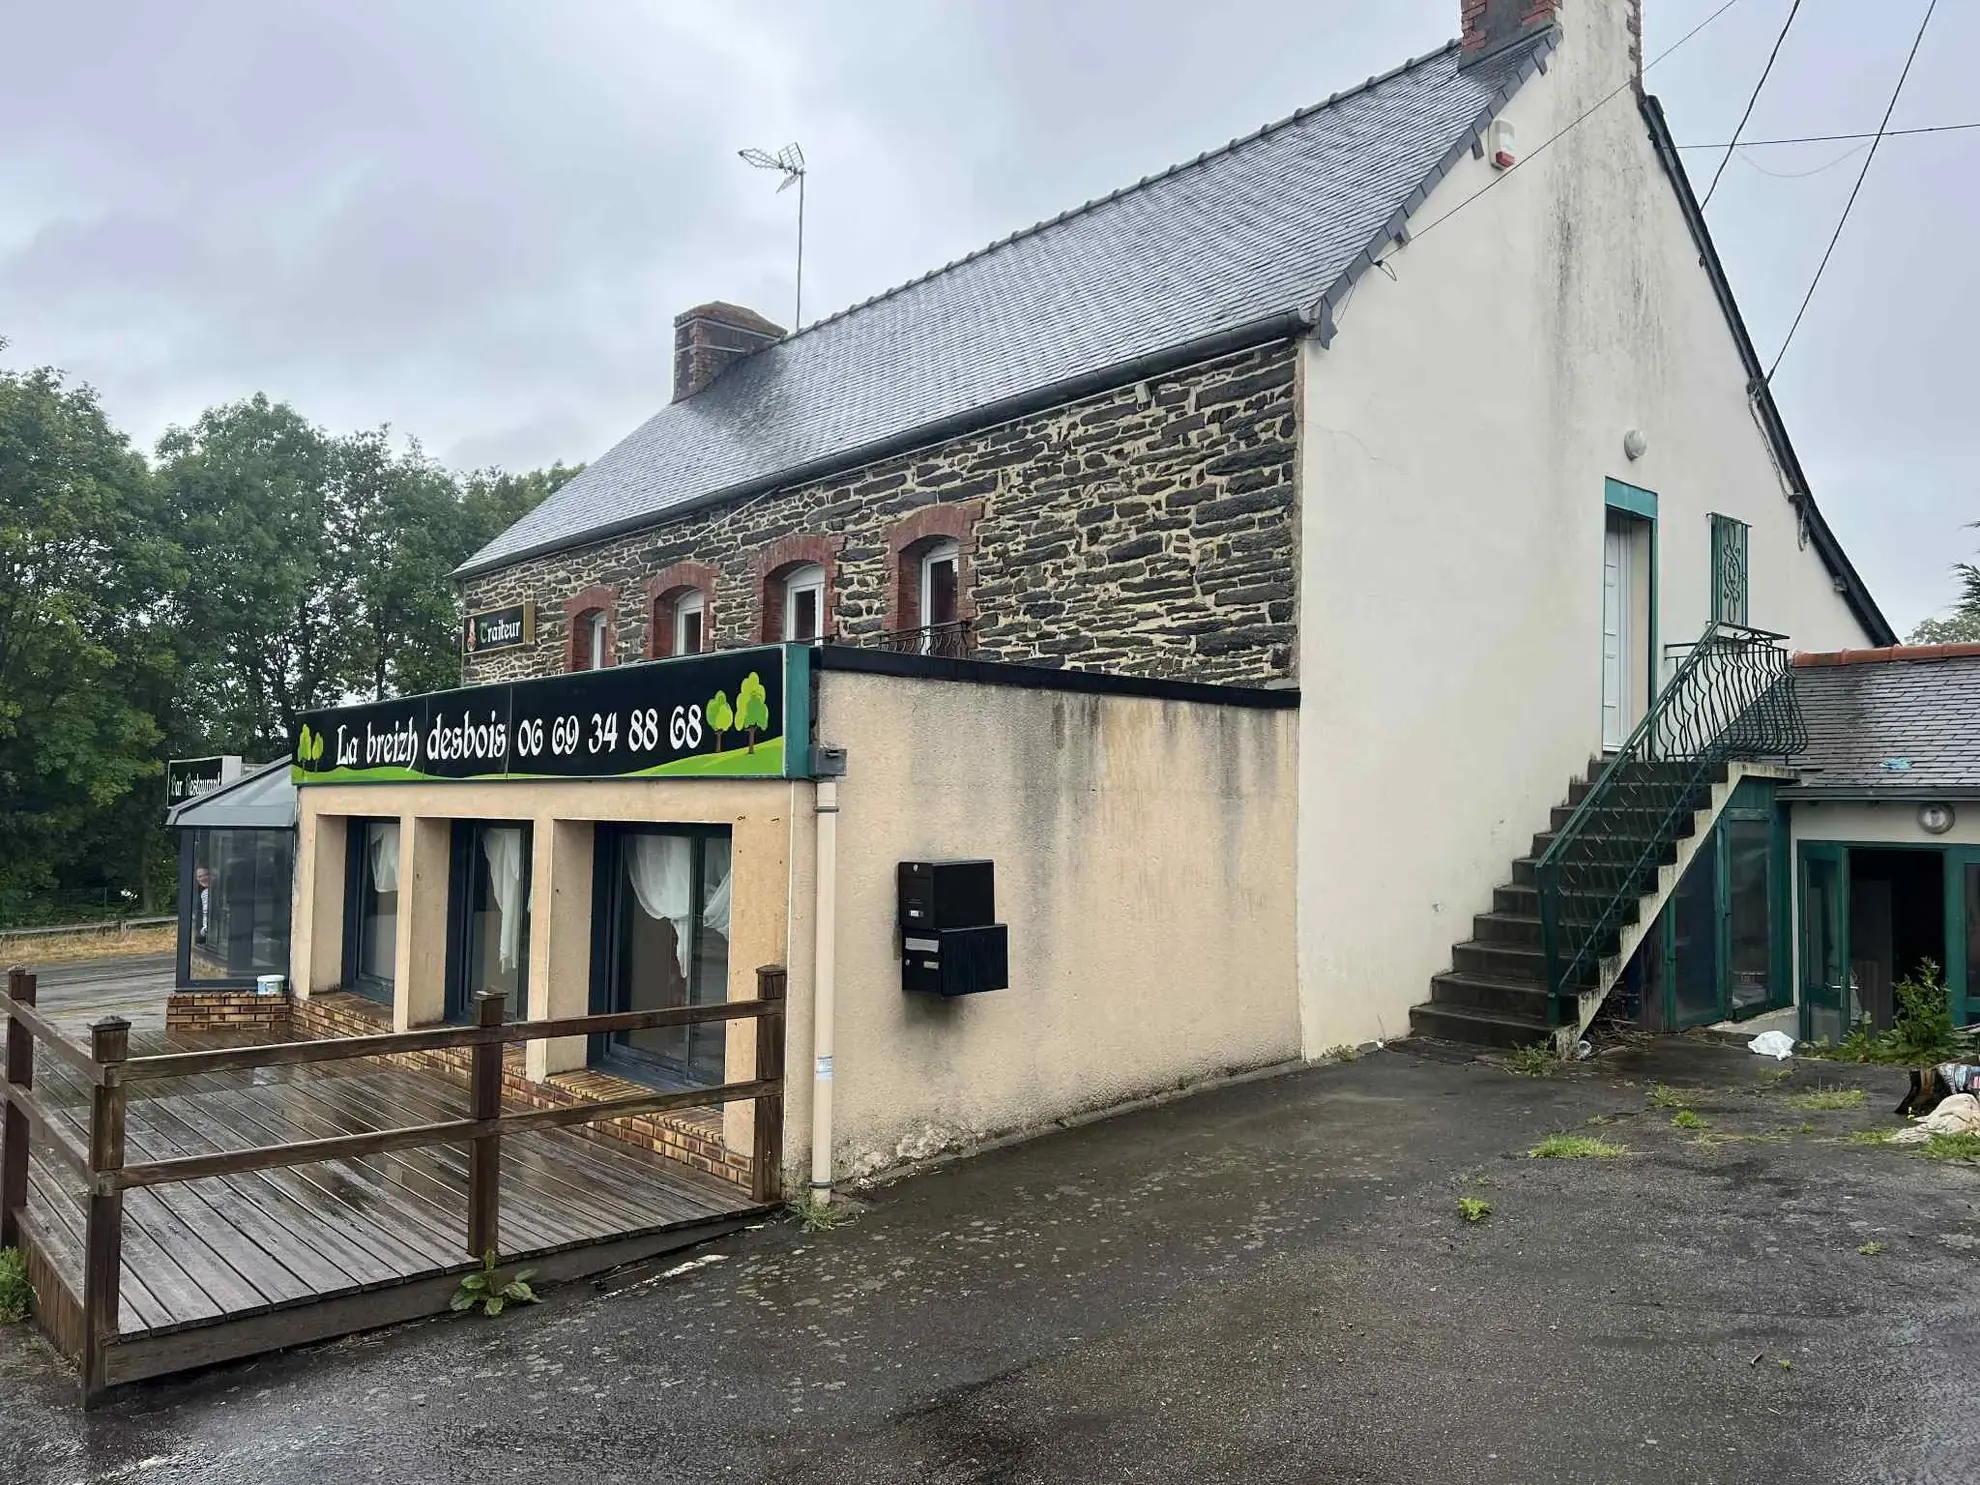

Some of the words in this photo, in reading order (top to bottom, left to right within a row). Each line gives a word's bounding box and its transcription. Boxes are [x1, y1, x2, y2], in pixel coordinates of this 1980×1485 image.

[480, 618, 521, 644] Traiteur
[336, 724, 358, 766] La
[366, 716, 419, 772] breizh
[426, 710, 507, 761] desbois
[517, 718, 544, 757] 06
[552, 715, 580, 755] 69
[588, 712, 618, 754] 34
[628, 708, 659, 752] 88
[669, 704, 702, 750] 68
